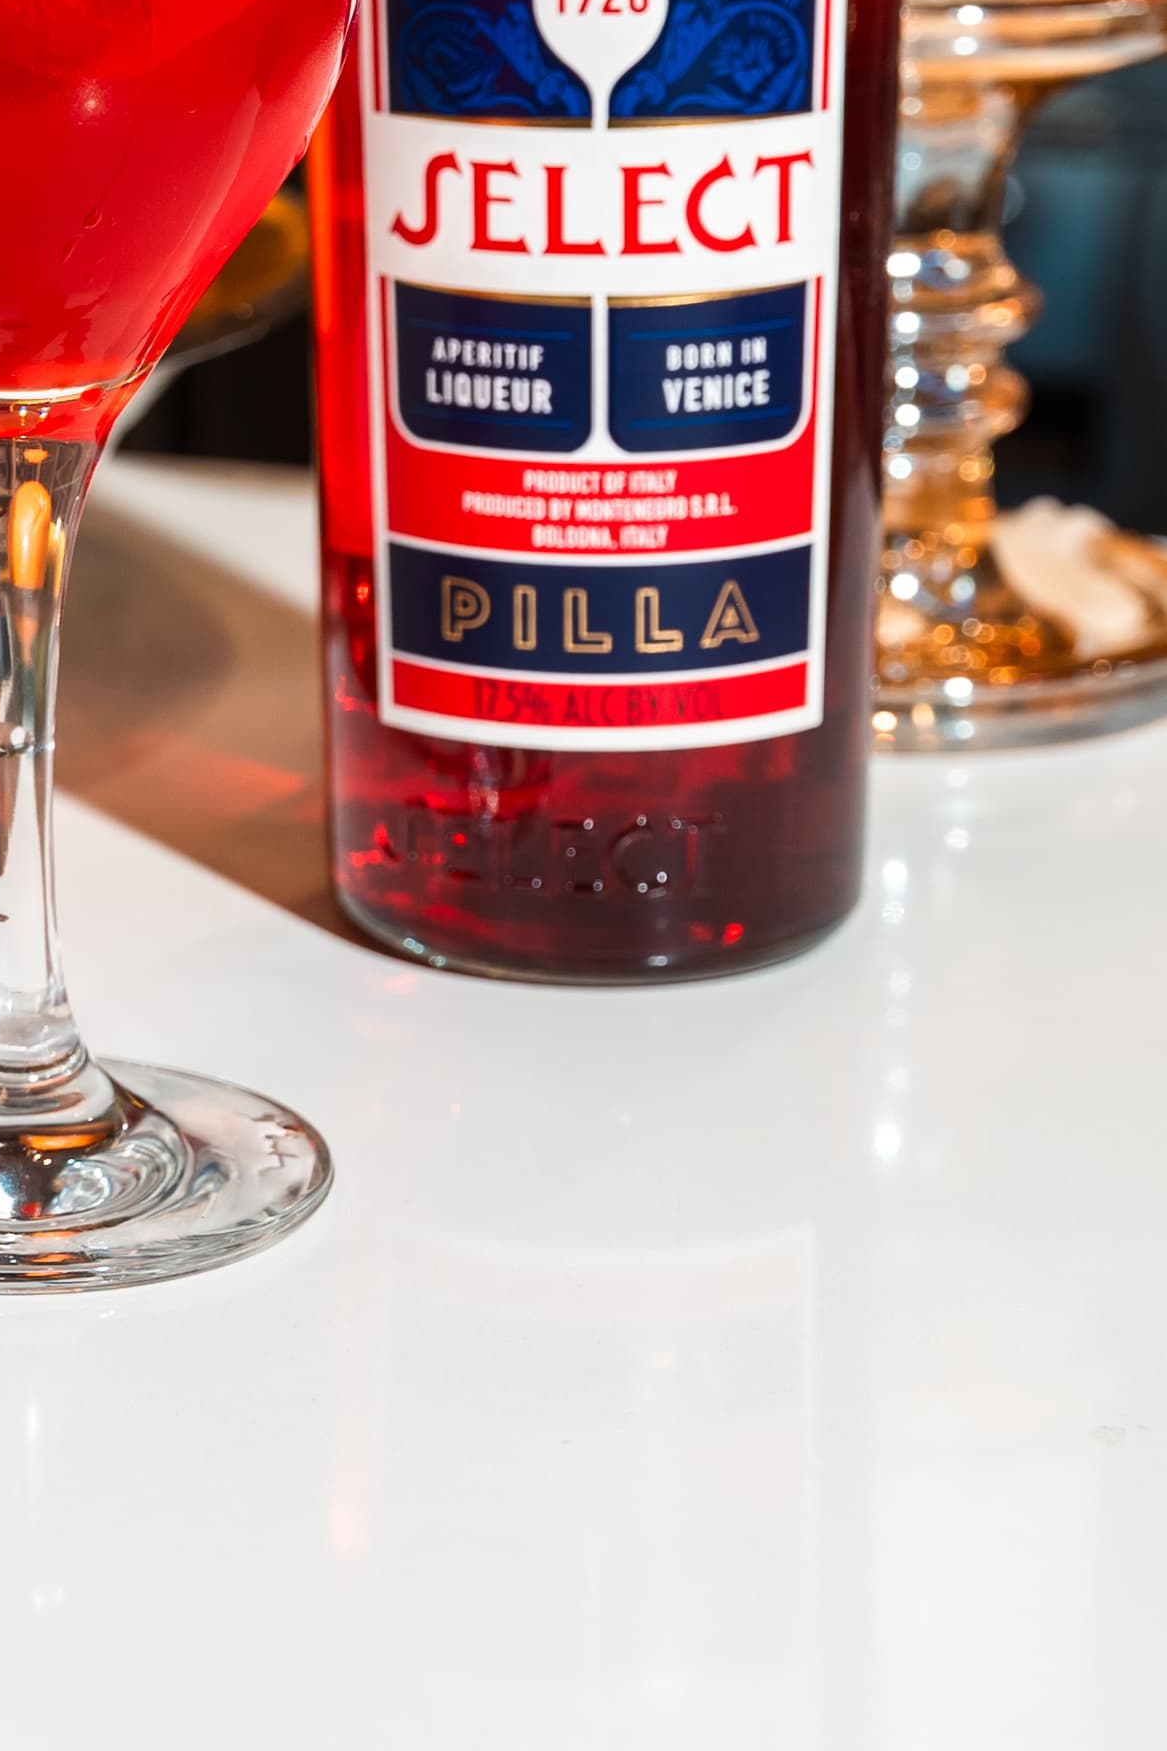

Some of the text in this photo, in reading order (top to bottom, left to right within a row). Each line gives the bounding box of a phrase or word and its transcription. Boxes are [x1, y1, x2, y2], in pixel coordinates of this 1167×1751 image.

[389, 149, 814, 256] SELECT
[432, 335, 544, 371] APERITIF
[666, 335, 767, 372] BORN IN
[426, 367, 552, 414] LIQUEUR
[662, 368, 770, 413] VENICE
[522, 468, 678, 495] PRODUCT OF ITALY
[461, 489, 546, 520] PRODUCED
[548, 497, 573, 521] BY
[574, 495, 688, 522] MONTENEGRO
[531, 523, 669, 550] BOLOGNA, ITALY
[440, 575, 761, 654] PILLA
